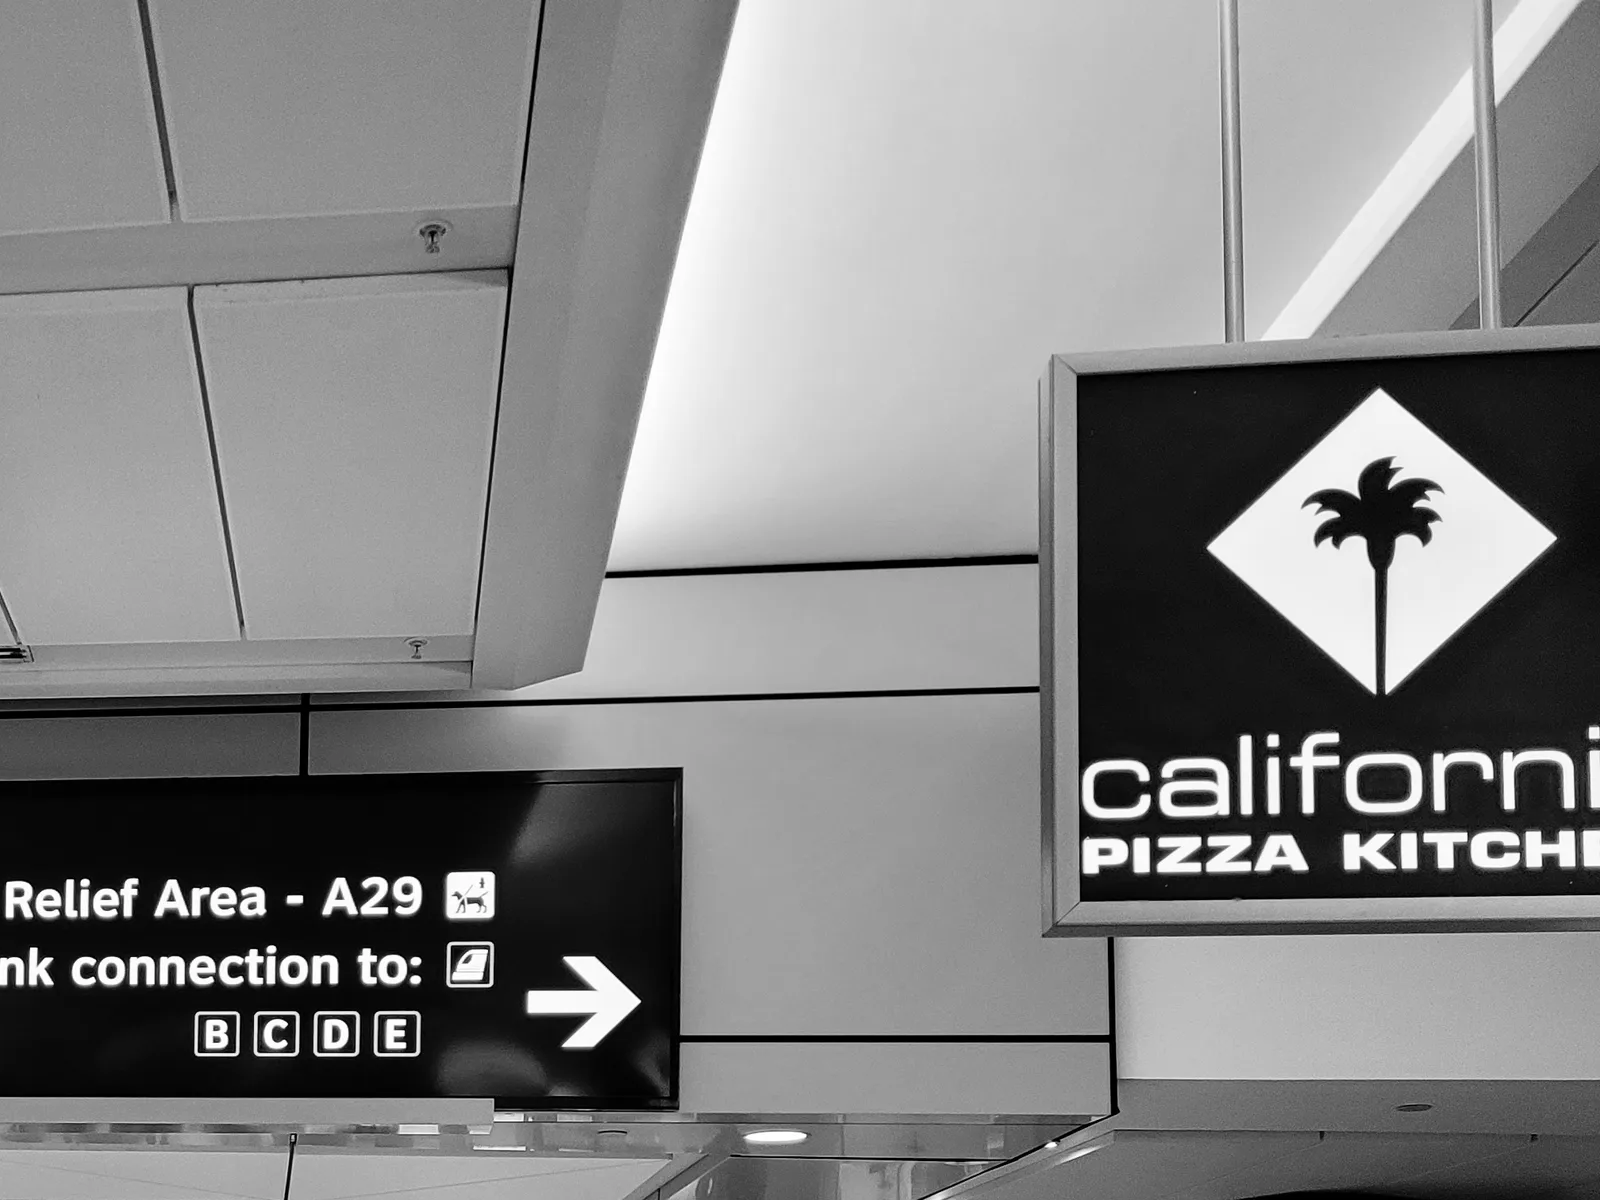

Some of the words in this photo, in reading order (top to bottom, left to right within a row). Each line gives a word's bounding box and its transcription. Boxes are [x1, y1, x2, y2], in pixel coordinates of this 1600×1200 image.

[1082, 726, 1600, 819] californi
[1082, 834, 1309, 874] PIZZA
[1343, 830, 1600, 871] KITCH
[5, 878, 139, 919] Relief
[154, 879, 266, 918] Area
[286, 895, 303, 905] -
[322, 876, 422, 916] A29
[72, 945, 338, 987] connection
[357, 948, 421, 985] to:
[205, 1022, 228, 1049] B
[263, 1020, 288, 1050] C
[323, 1020, 349, 1050] D
[385, 1020, 406, 1049] E
